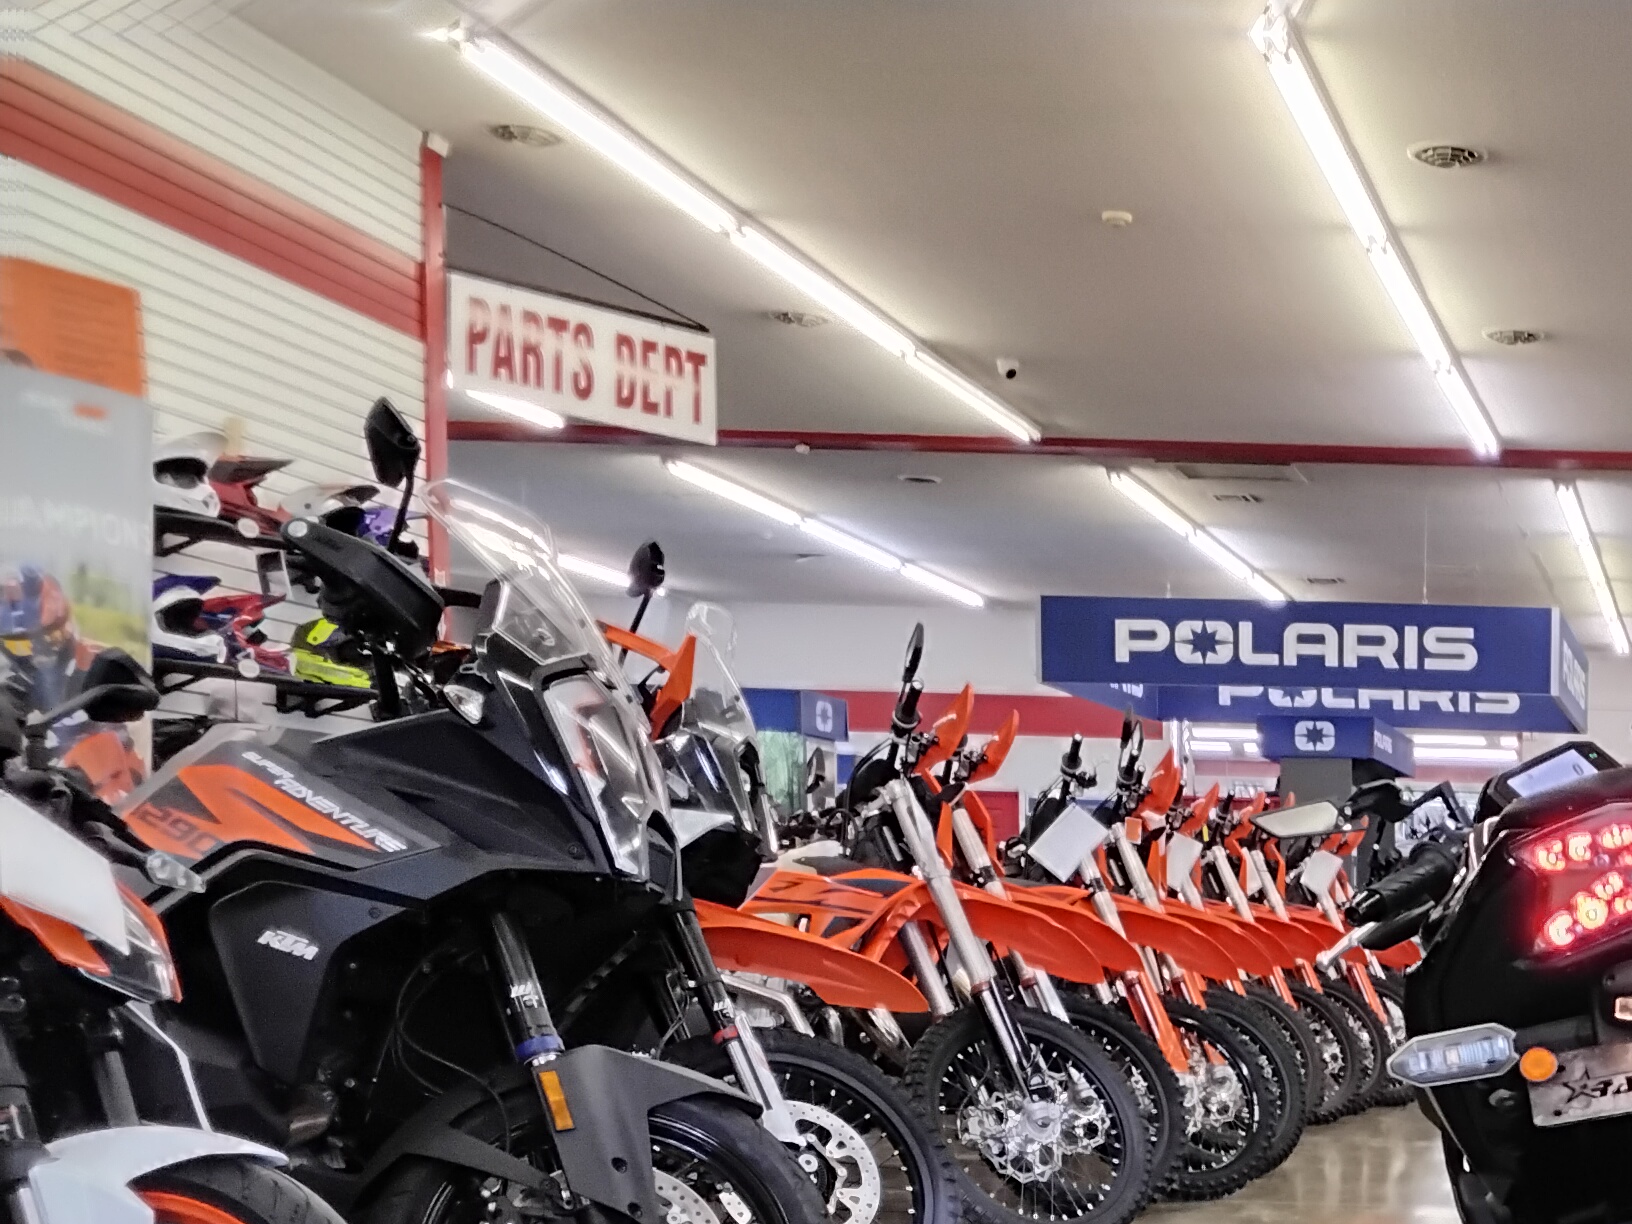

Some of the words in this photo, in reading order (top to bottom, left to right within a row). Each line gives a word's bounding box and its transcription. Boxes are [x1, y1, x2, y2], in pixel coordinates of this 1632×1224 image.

[465, 296, 595, 400] PARTS
[615, 330, 707, 425] DEPT
[1114, 618, 1478, 672] POLARIS
[273, 778, 408, 852] ADVENTURE
[257, 930, 319, 961] KTM
